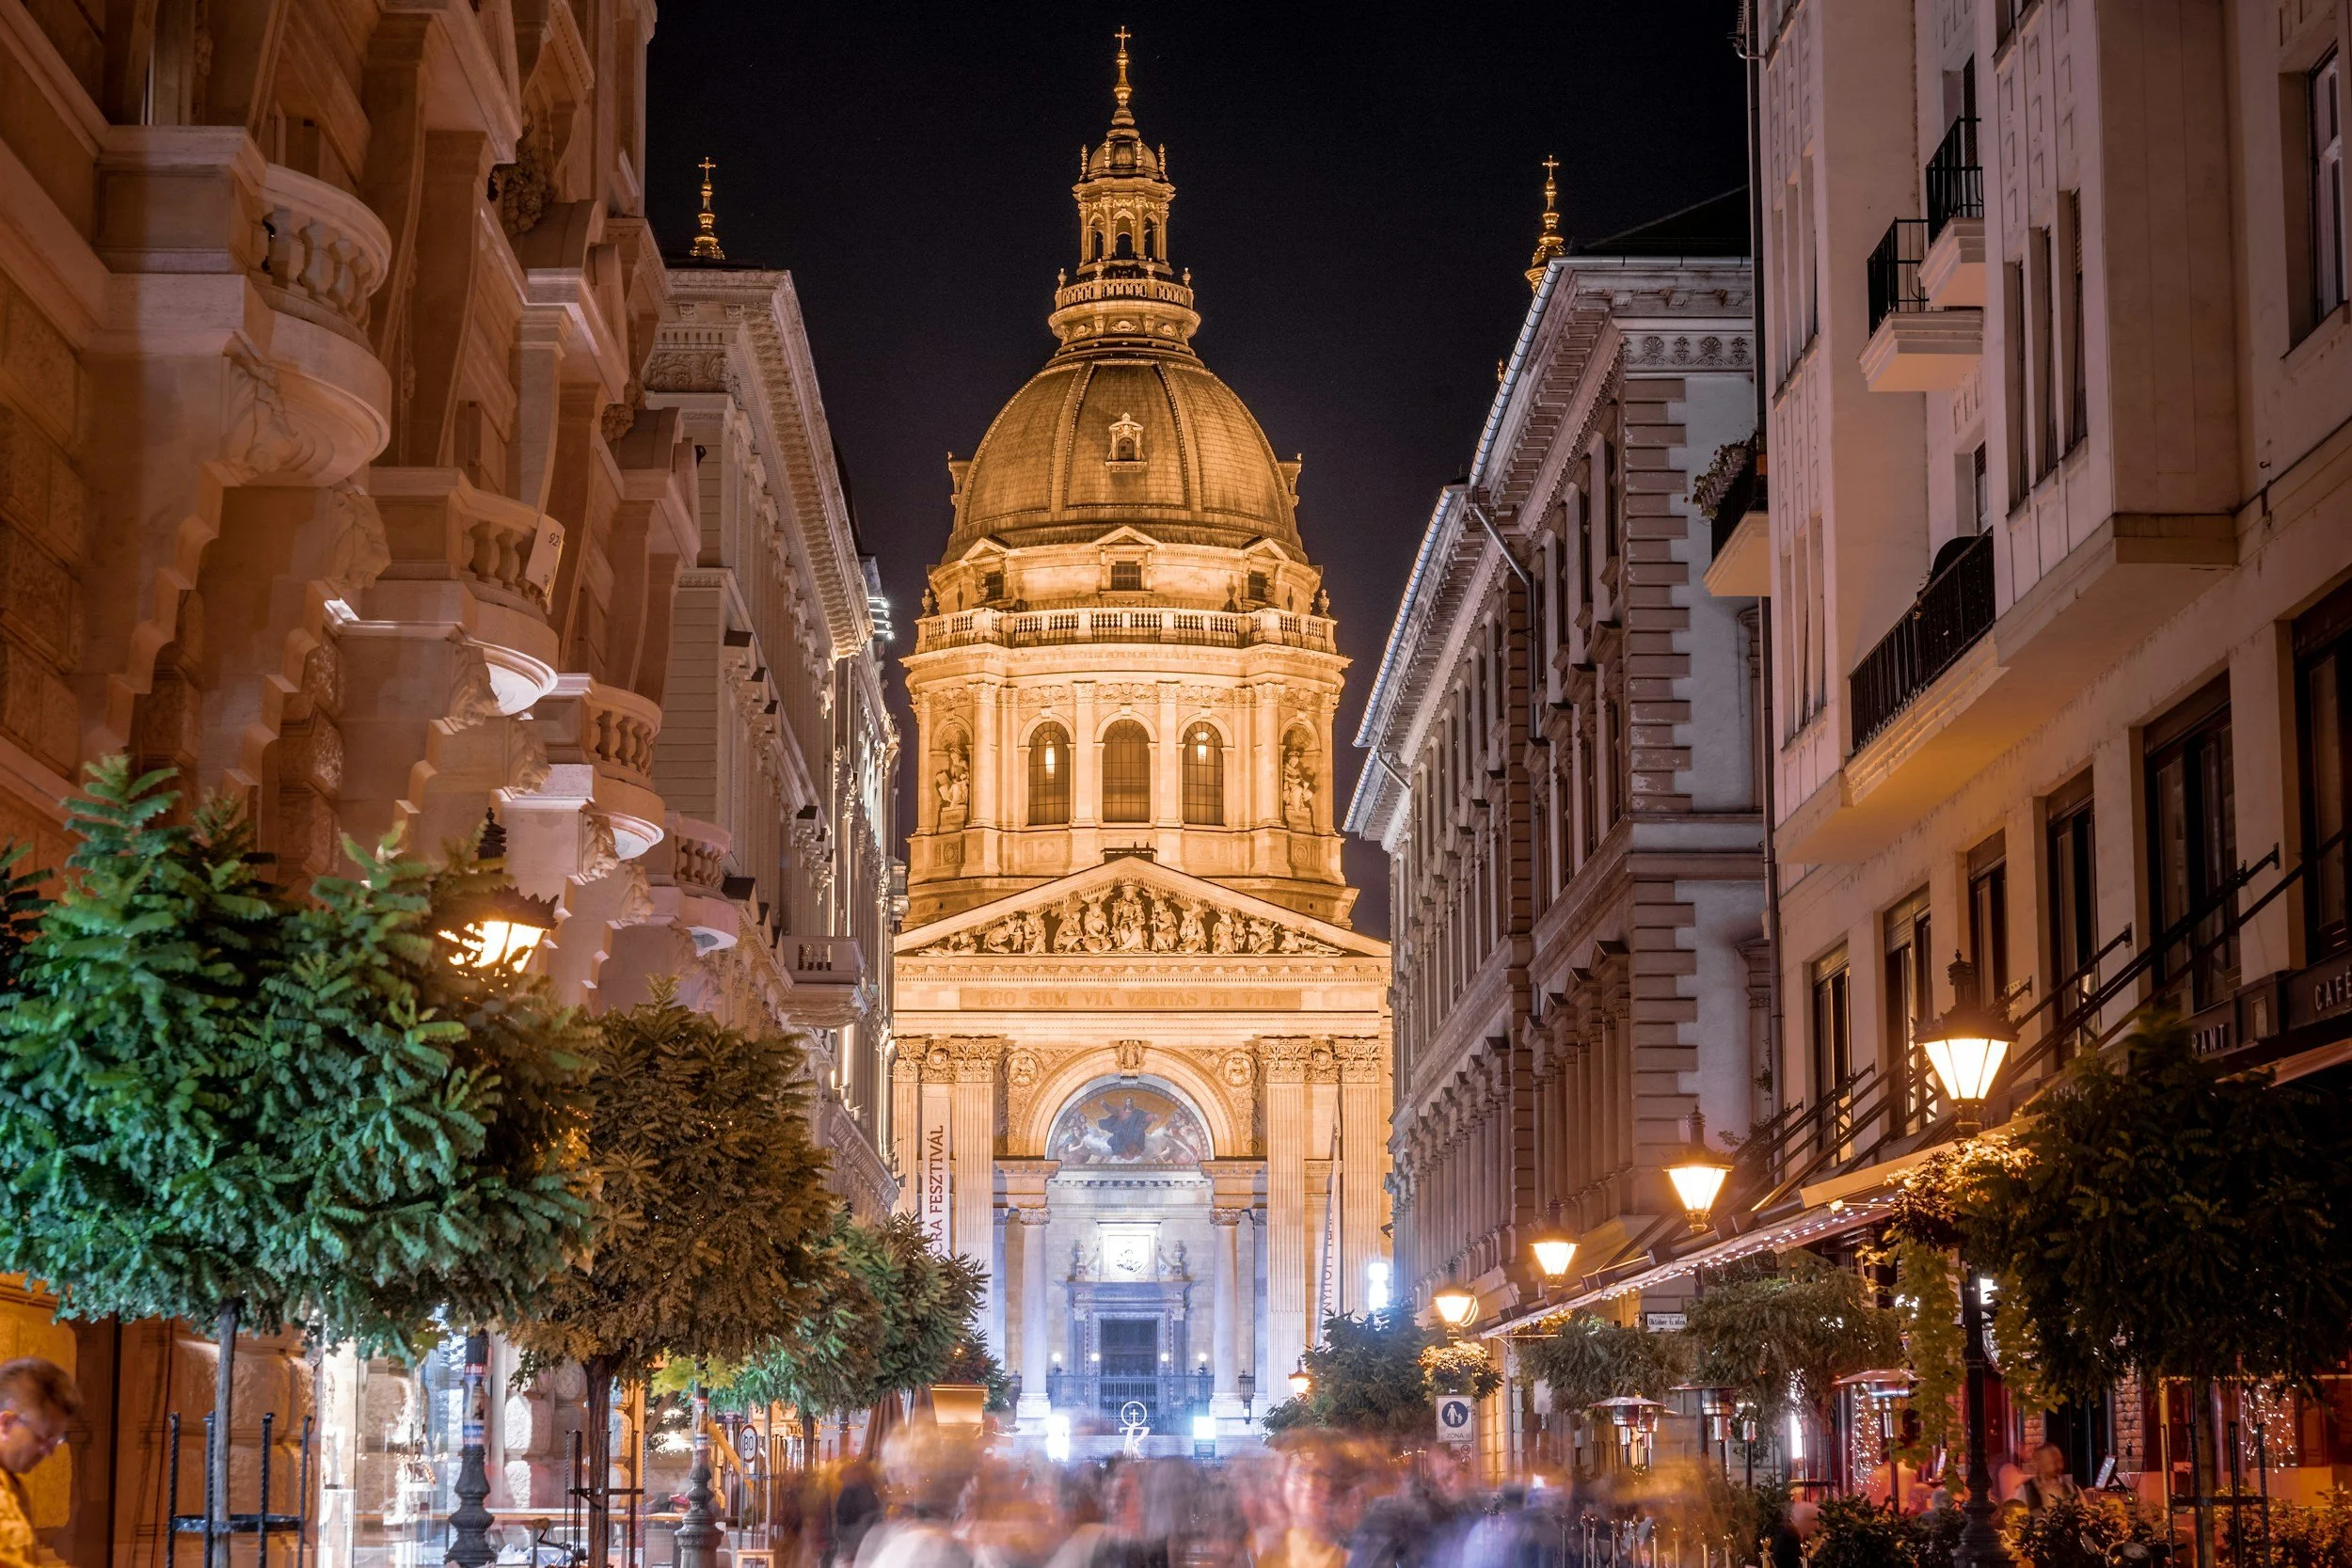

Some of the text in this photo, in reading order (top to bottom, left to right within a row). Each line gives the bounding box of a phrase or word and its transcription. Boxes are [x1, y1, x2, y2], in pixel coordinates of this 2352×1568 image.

[978, 991, 1281, 1006] EGO SUM VIA VERITAS ET VITA
[2314, 964, 2352, 1011] CAFÉ
[2191, 1023, 2225, 1055] RANT
[927, 1125, 944, 1213] FESZTIVÁL
